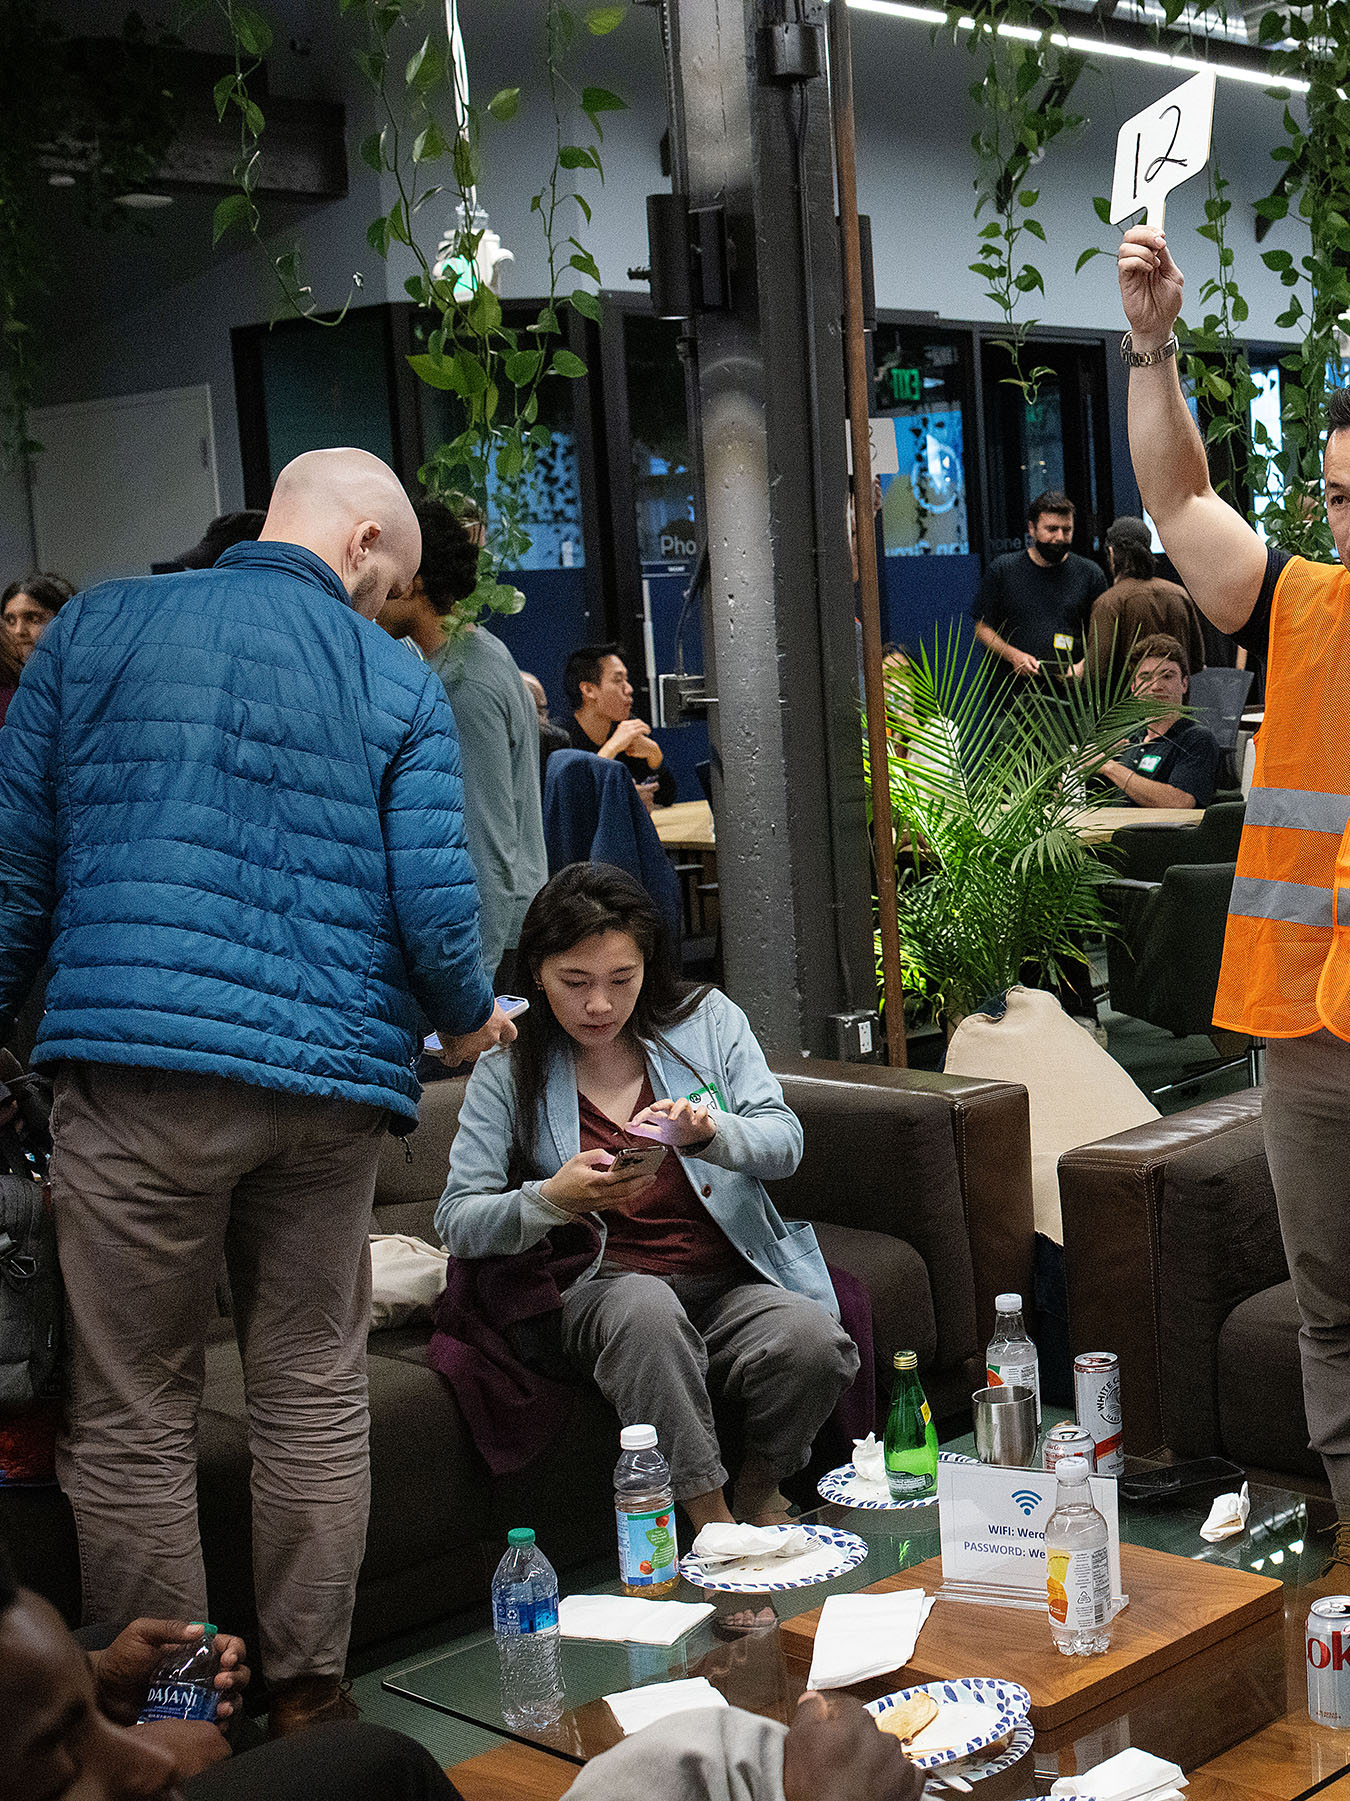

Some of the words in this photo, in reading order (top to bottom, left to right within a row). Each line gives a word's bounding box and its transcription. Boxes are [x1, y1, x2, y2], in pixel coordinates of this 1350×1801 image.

[1133, 105, 1187, 199] 12
[1097, 1380, 1113, 1412] WHITE
[988, 1524, 1015, 1537] WIFI:
[964, 1541, 1026, 1557] PASSWORD:
[1029, 1548, 1046, 1559] We
[147, 1685, 198, 1706] DASANI
